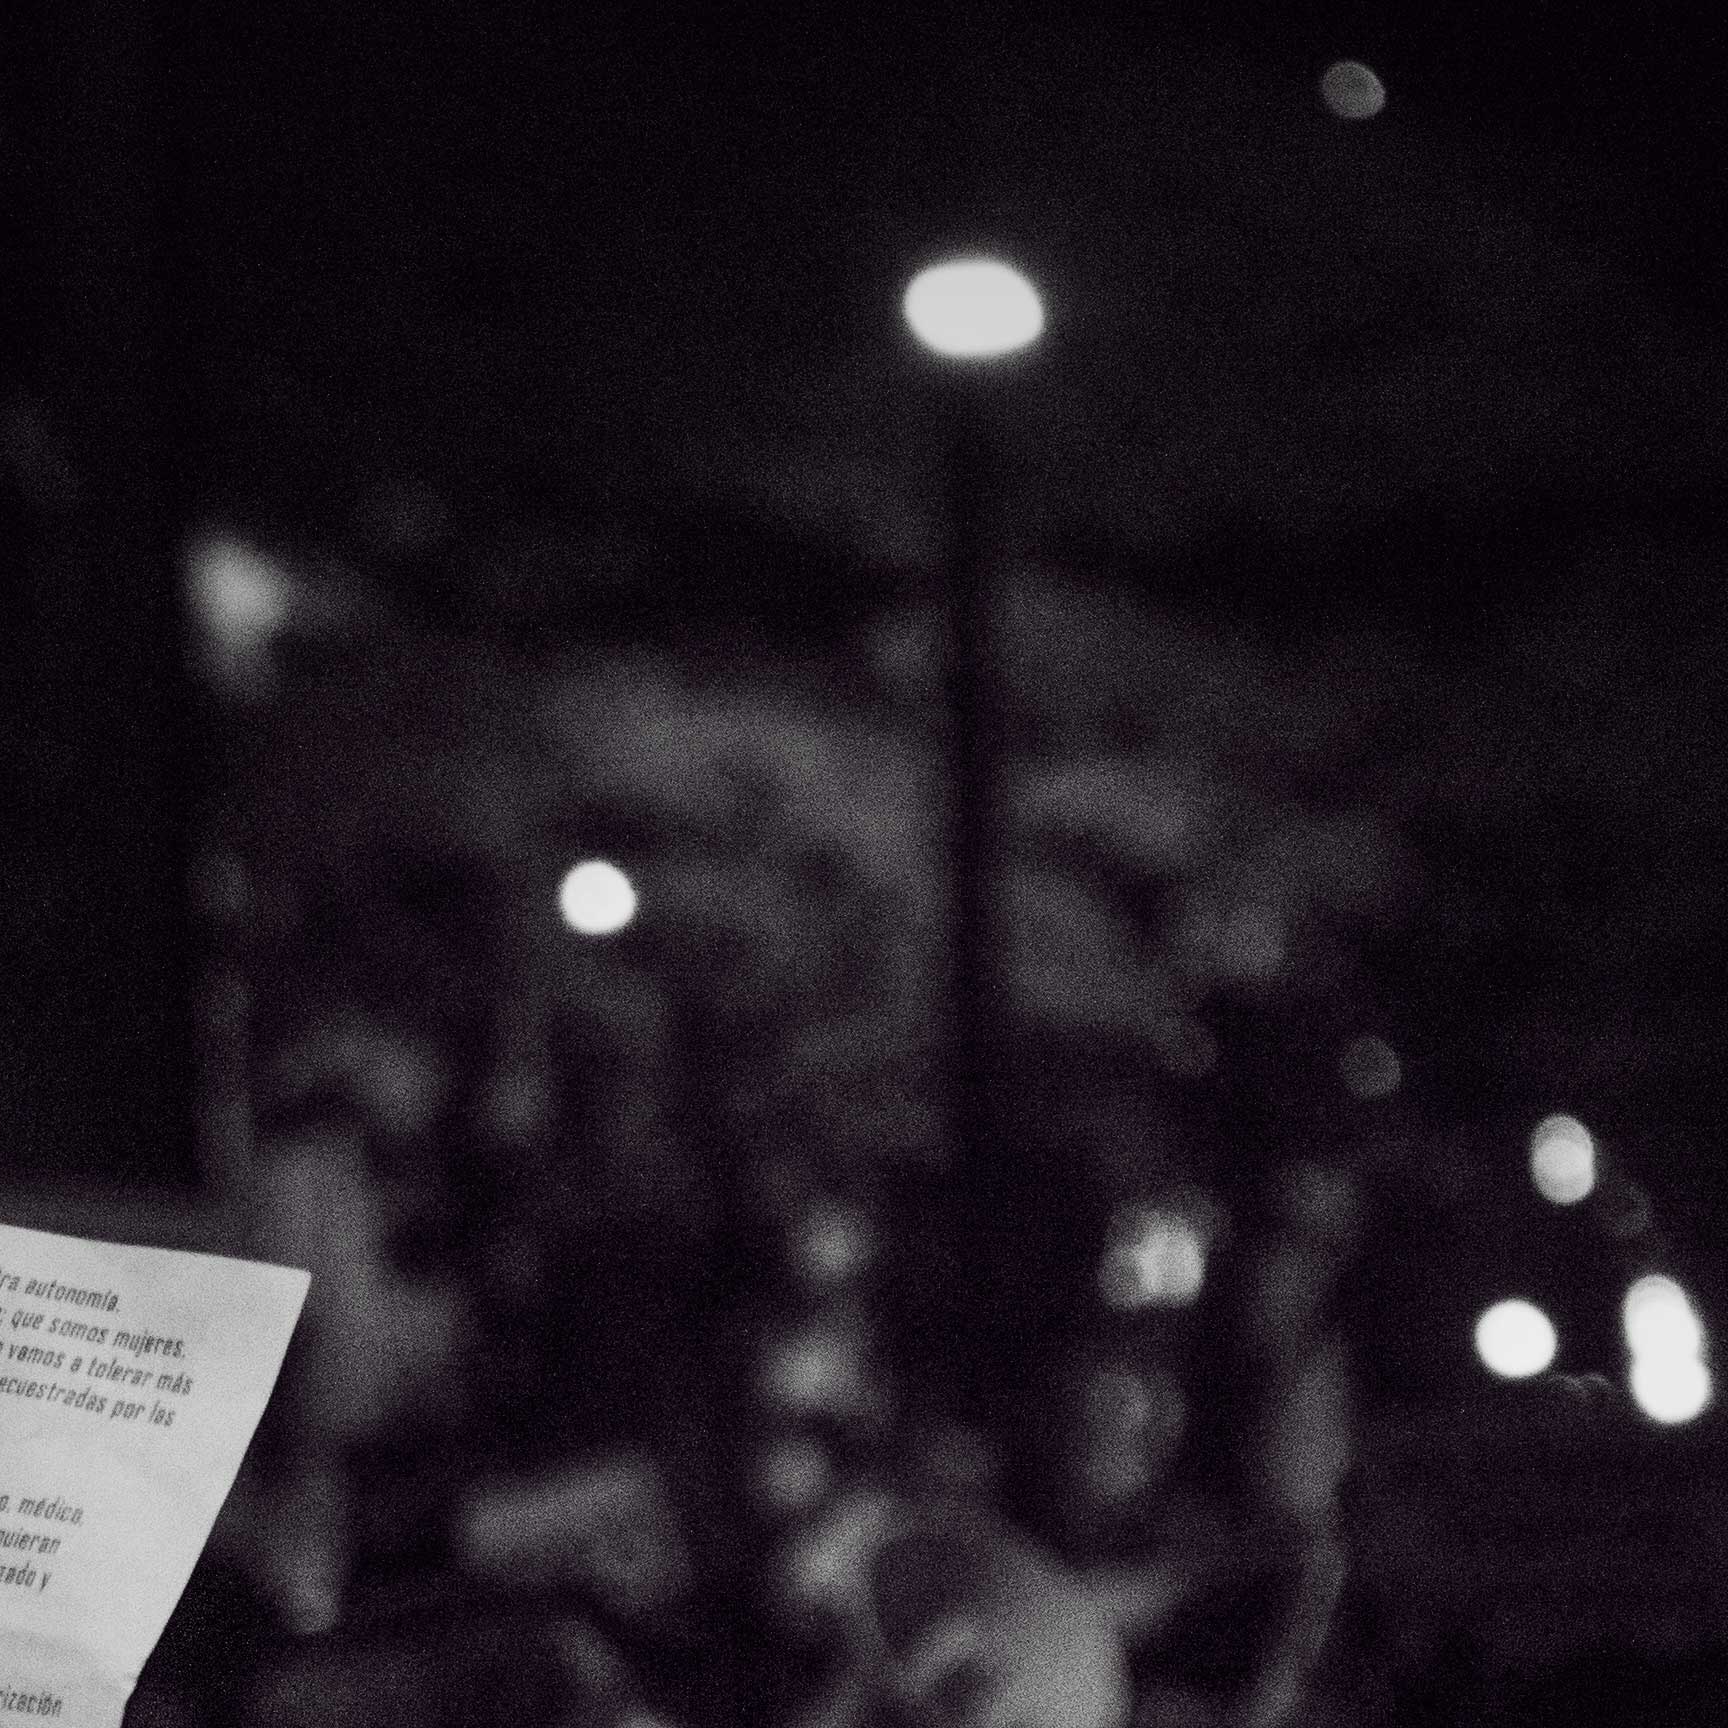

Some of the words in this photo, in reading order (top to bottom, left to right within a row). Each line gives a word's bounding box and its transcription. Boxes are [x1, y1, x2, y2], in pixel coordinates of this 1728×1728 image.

[7, 1343, 66, 1369] vamos
[69, 1356, 84, 1374] a
[86, 1357, 154, 1387] tolerar
[155, 1372, 194, 1396] más
